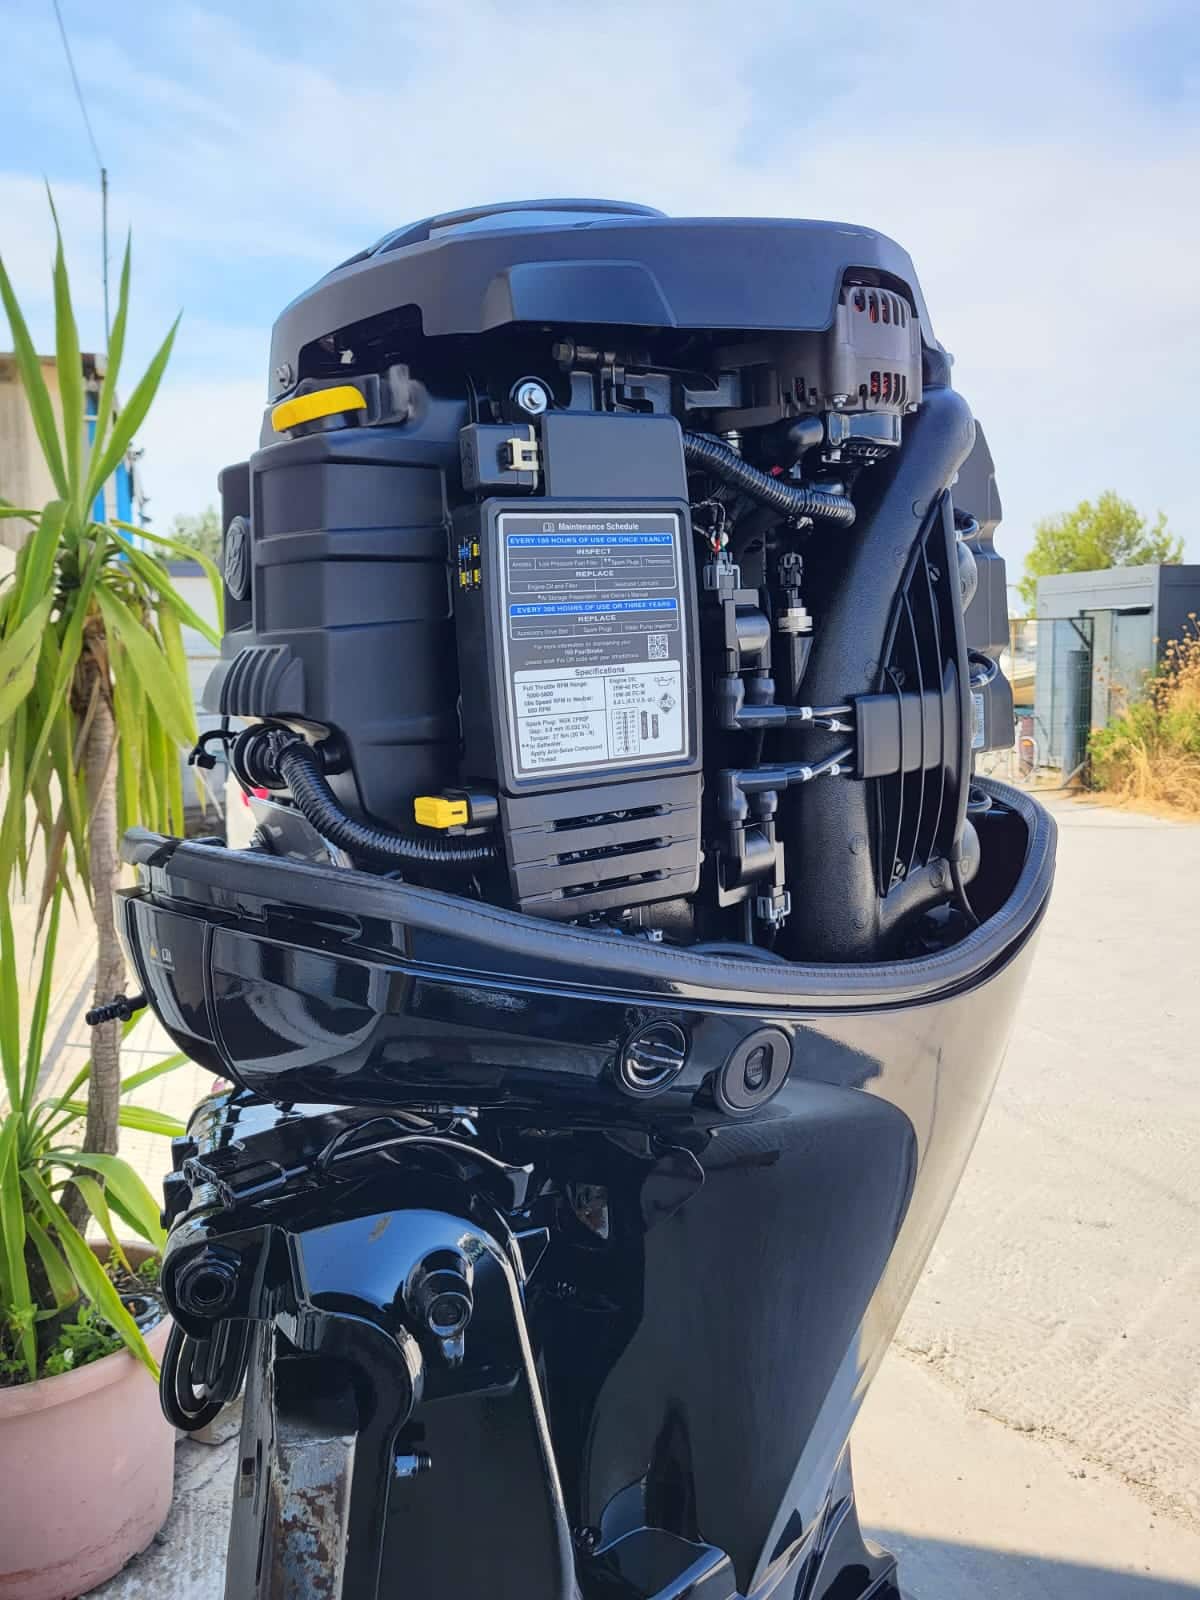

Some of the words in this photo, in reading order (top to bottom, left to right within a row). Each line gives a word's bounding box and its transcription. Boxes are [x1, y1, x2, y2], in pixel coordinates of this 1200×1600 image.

[558, 522, 604, 531] Maintenance
[606, 522, 639, 531] Schedule
[510, 537, 536, 545] EVERY
[590, 536, 605, 544] USE
[618, 536, 638, 544] ONCE
[574, 667, 625, 676] Specifications
